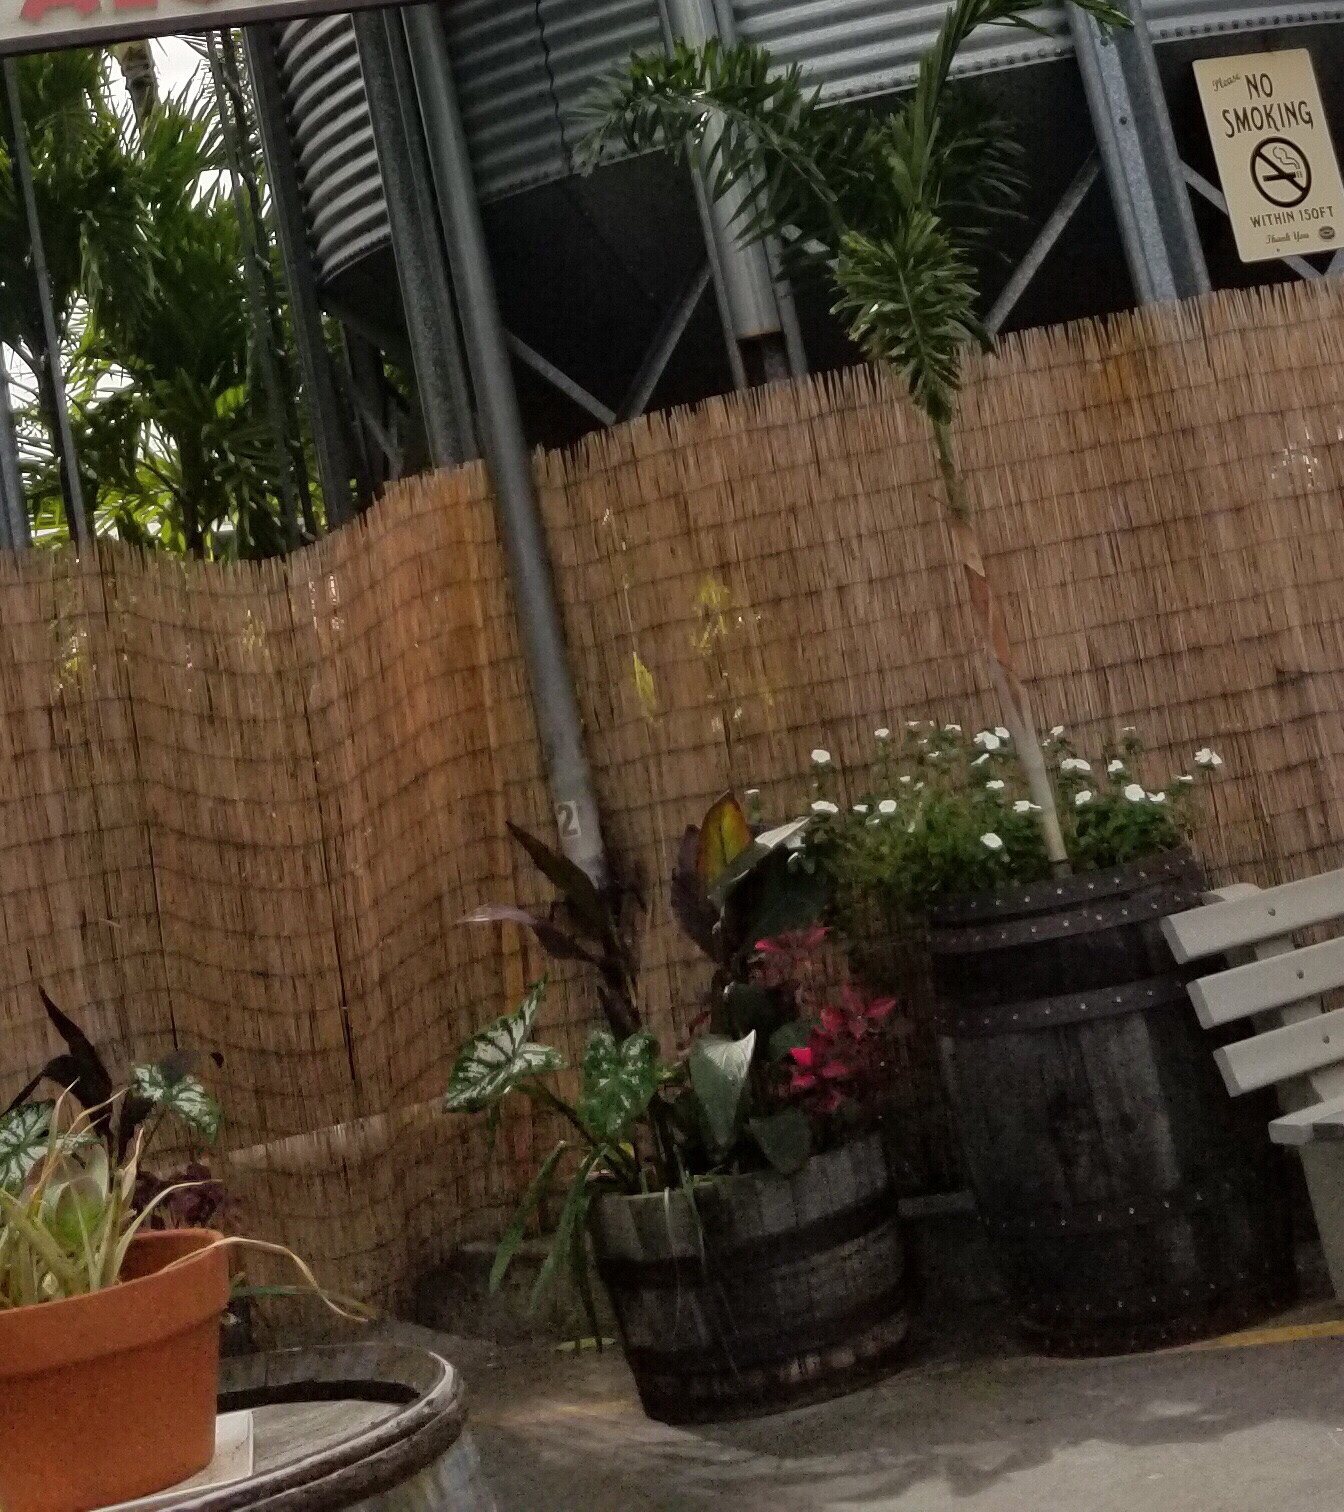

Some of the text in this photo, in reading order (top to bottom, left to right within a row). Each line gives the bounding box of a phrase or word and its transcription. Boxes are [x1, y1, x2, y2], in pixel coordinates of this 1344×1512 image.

[1212, 72, 1273, 100] Please NO
[1222, 100, 1314, 138] SMOKING
[1249, 210, 1296, 228] WITHIN
[1265, 232, 1291, 244] Thank
[557, 803, 579, 837] 2
